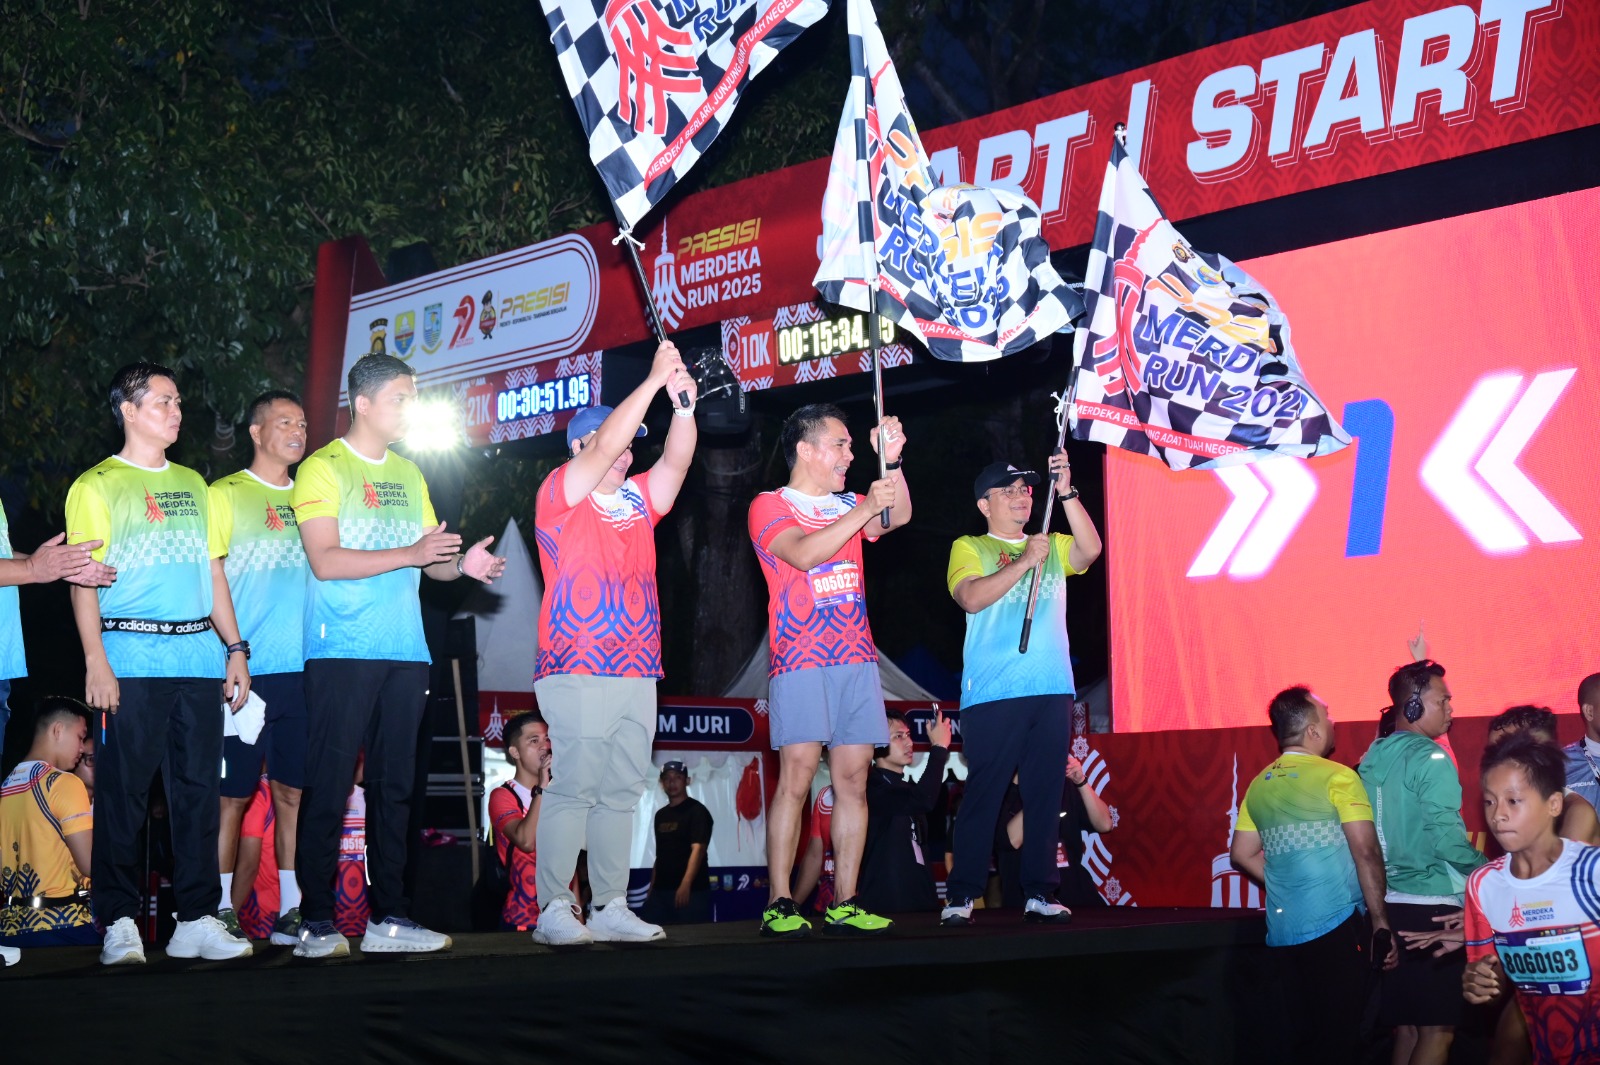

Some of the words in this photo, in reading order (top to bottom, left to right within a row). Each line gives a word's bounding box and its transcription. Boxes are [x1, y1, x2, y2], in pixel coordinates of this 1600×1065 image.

[648, 138, 684, 179] MERDEKA
[685, 103, 715, 139] BERLARI,
[714, 63, 742, 106] JUNJUNG
[736, 44, 747, 68] ADAT
[744, 22, 766, 48] TUAH
[1185, 0, 1552, 173] START
[677, 217, 762, 260] PRESISI
[680, 246, 761, 286] MERDEKA
[500, 281, 571, 319] PRESISI
[687, 280, 719, 310] RUN
[721, 272, 762, 302] 2025
[741, 331, 771, 370] 10K
[778, 314, 895, 363] 00:15:34.5
[1141, 303, 1260, 376] MERD
[1143, 352, 1222, 402] RUN
[467, 393, 492, 427] 21K
[497, 373, 590, 422] 00:30:51.95
[1075, 402, 1120, 421] MERDEKA
[1122, 415, 1142, 426] BERL
[1160, 430, 1182, 447] ADAT
[1184, 437, 1204, 452] TUAH
[179, 508, 199, 517] 2025
[391, 499, 409, 508] 2025
[119, 620, 158, 633] adidas
[176, 621, 205, 634] adidas
[683, 715, 730, 735] JURI
[1522, 907, 1554, 916] MERDEKA
[1503, 948, 1579, 974] 8060193
